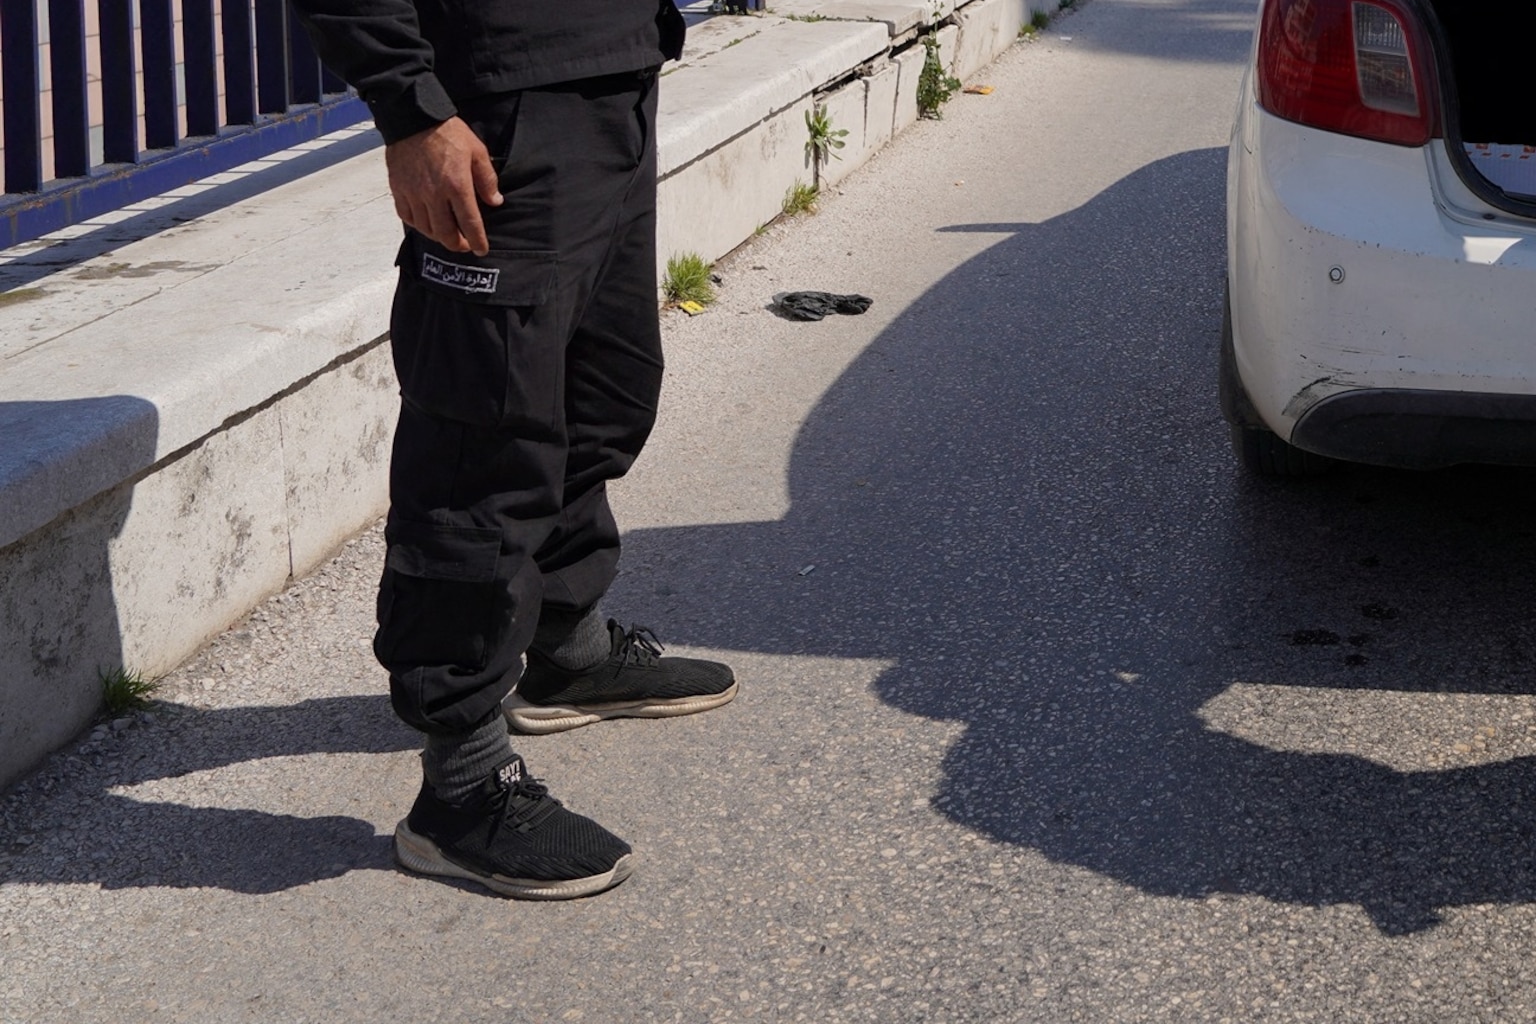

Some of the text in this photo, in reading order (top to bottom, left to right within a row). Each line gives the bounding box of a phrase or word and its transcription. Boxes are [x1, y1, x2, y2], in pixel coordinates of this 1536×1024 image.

[425, 260, 493, 288] إدارة الأمن العام
